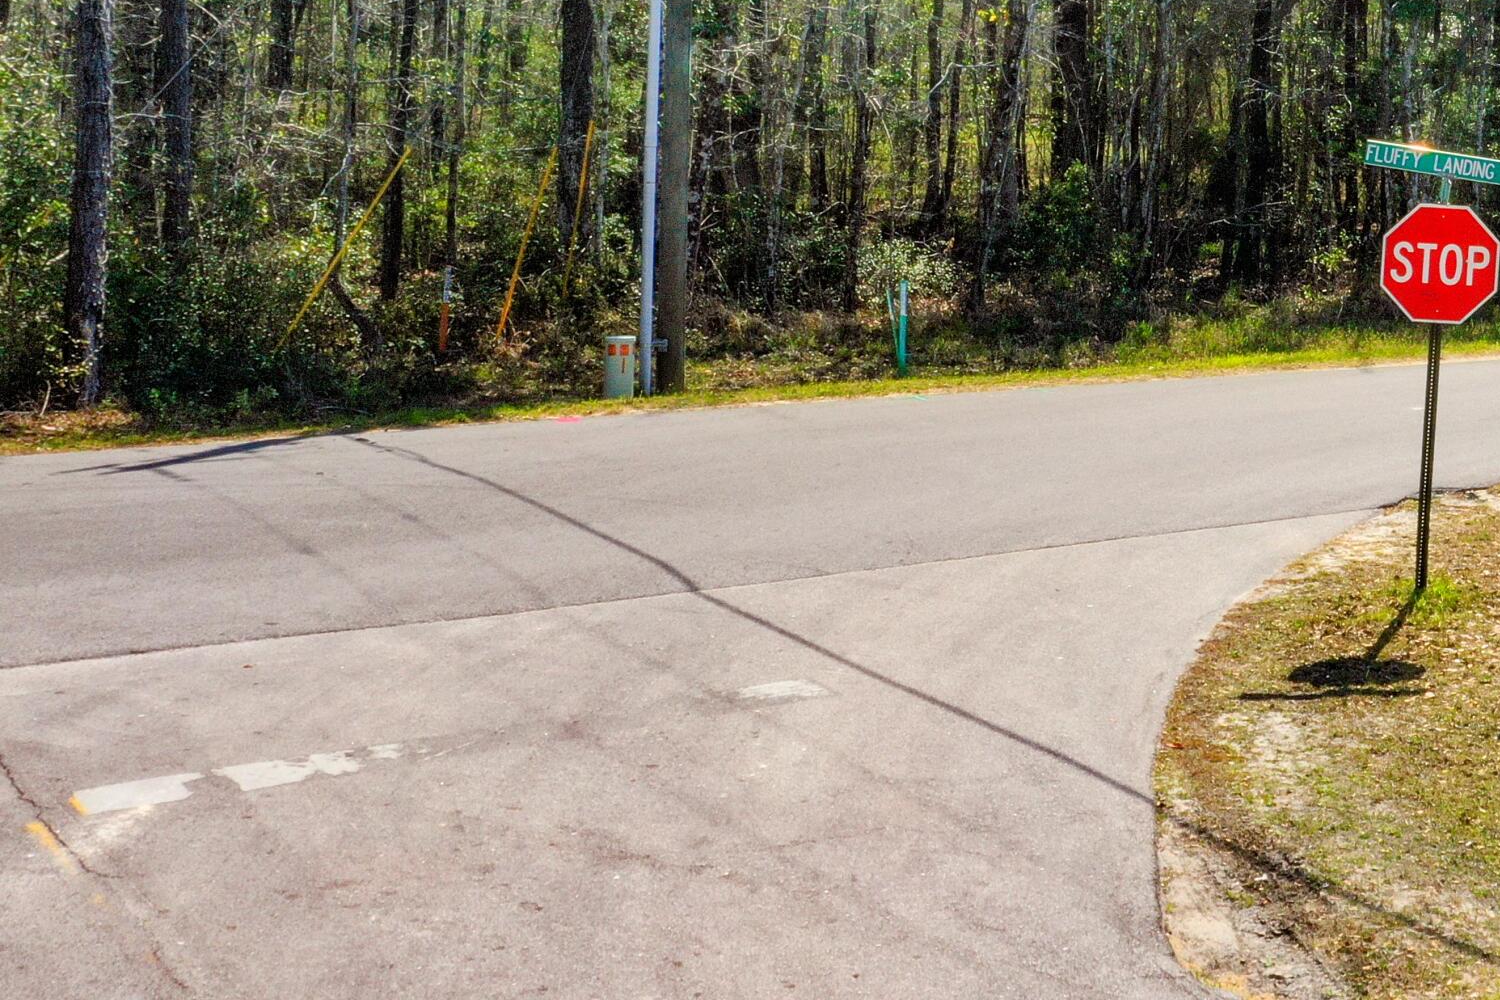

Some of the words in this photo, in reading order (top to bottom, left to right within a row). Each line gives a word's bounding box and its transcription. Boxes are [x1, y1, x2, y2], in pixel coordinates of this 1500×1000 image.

[1365, 144, 1422, 168] FLUFFY
[1433, 155, 1496, 180] LANDING
[1389, 241, 1491, 286] STOP
